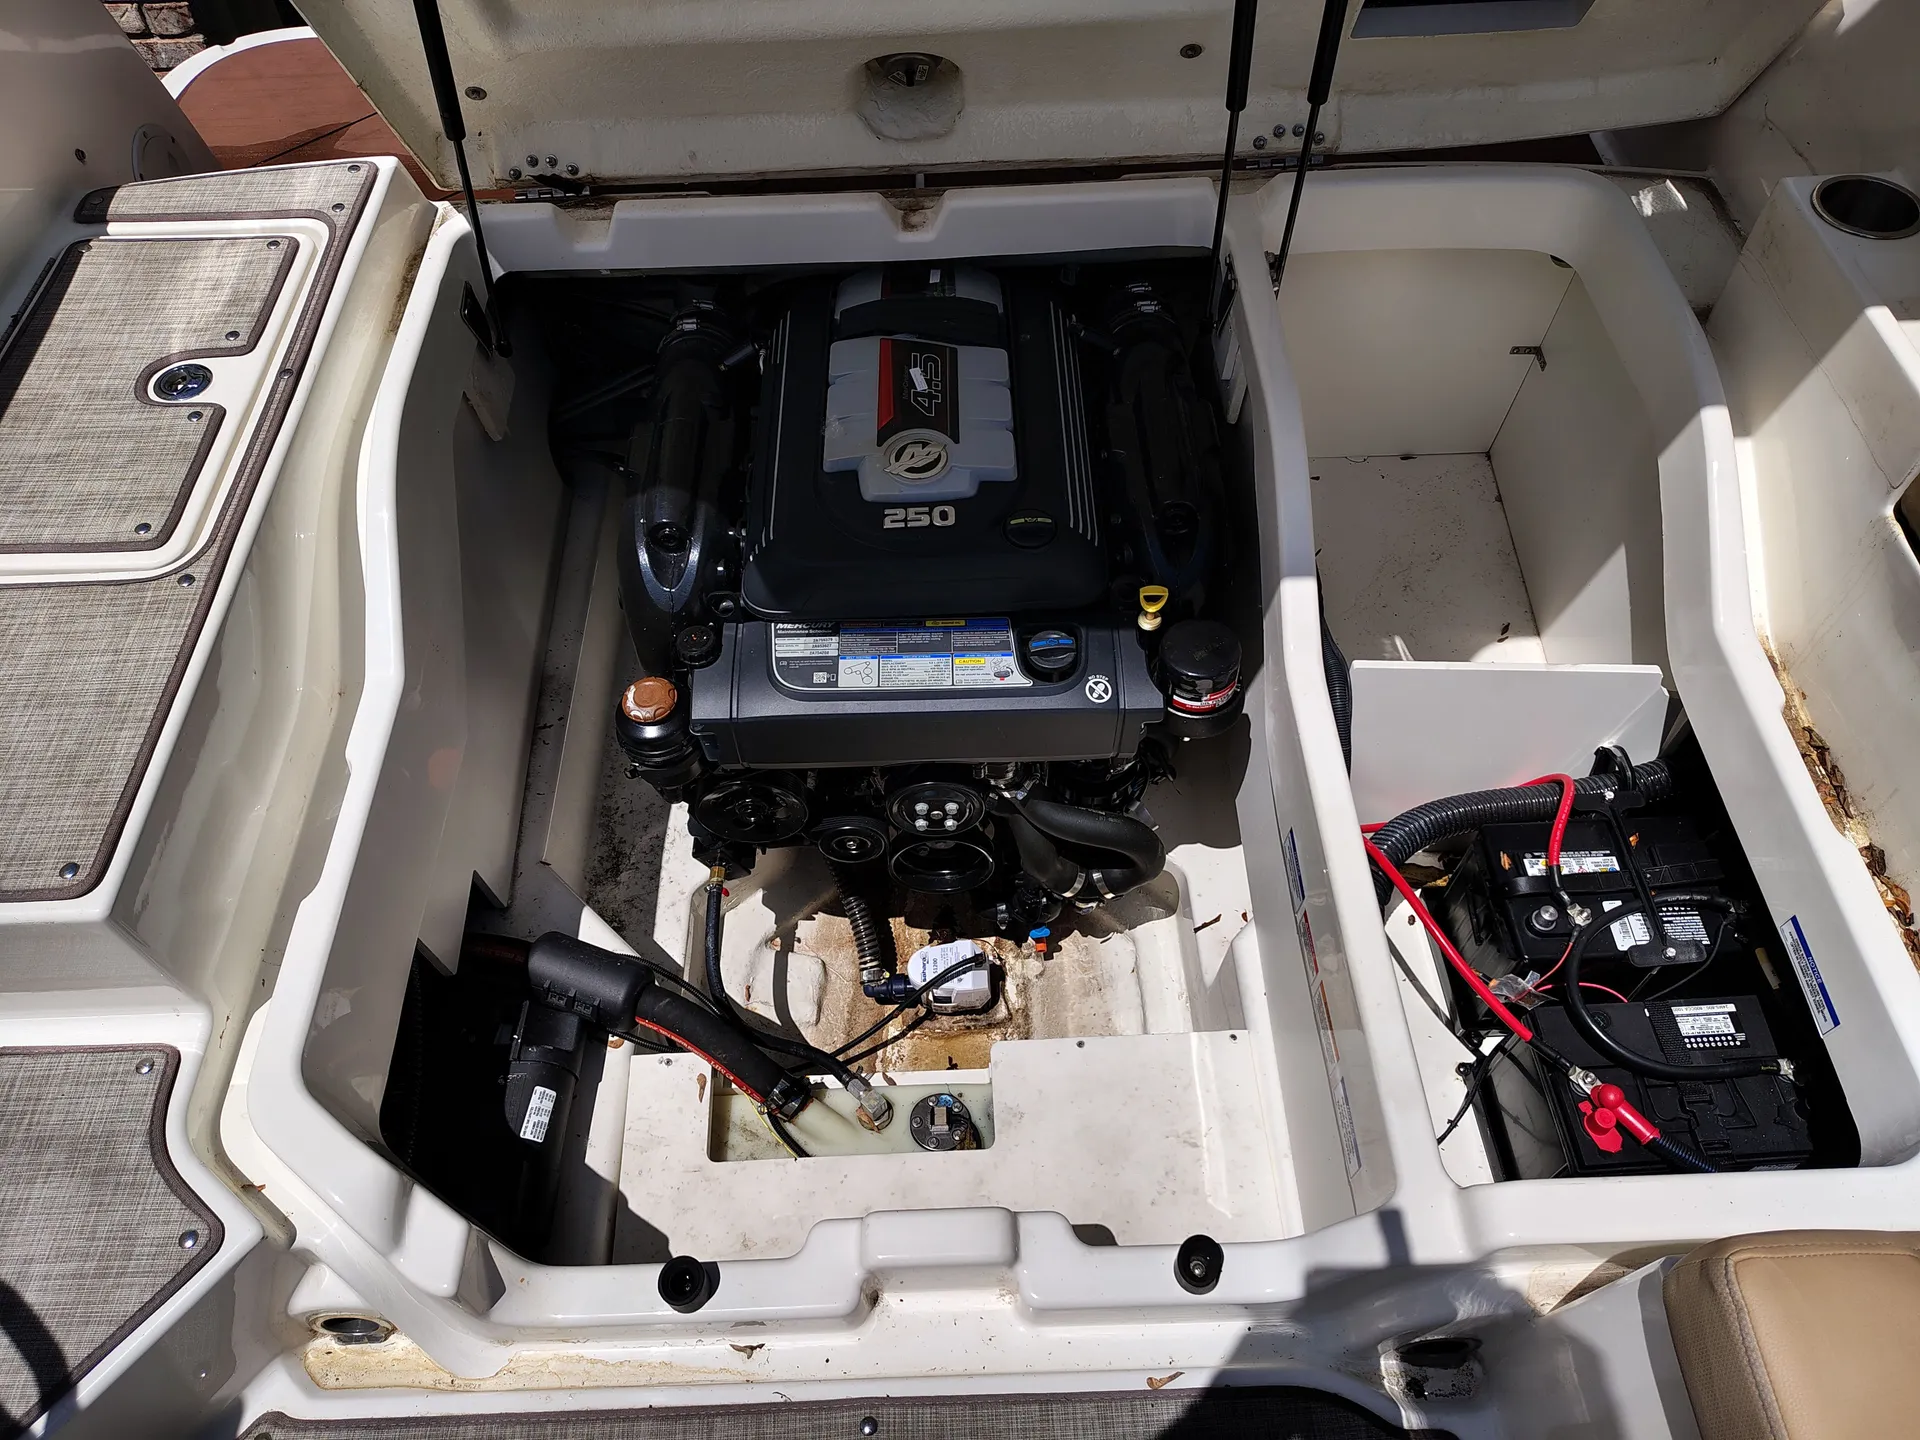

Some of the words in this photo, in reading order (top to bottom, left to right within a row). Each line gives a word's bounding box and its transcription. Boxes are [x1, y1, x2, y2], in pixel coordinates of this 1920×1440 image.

[911, 353, 941, 417] 4.5
[883, 505, 956, 529] 250
[1808, 957, 1822, 984] NOTICE
